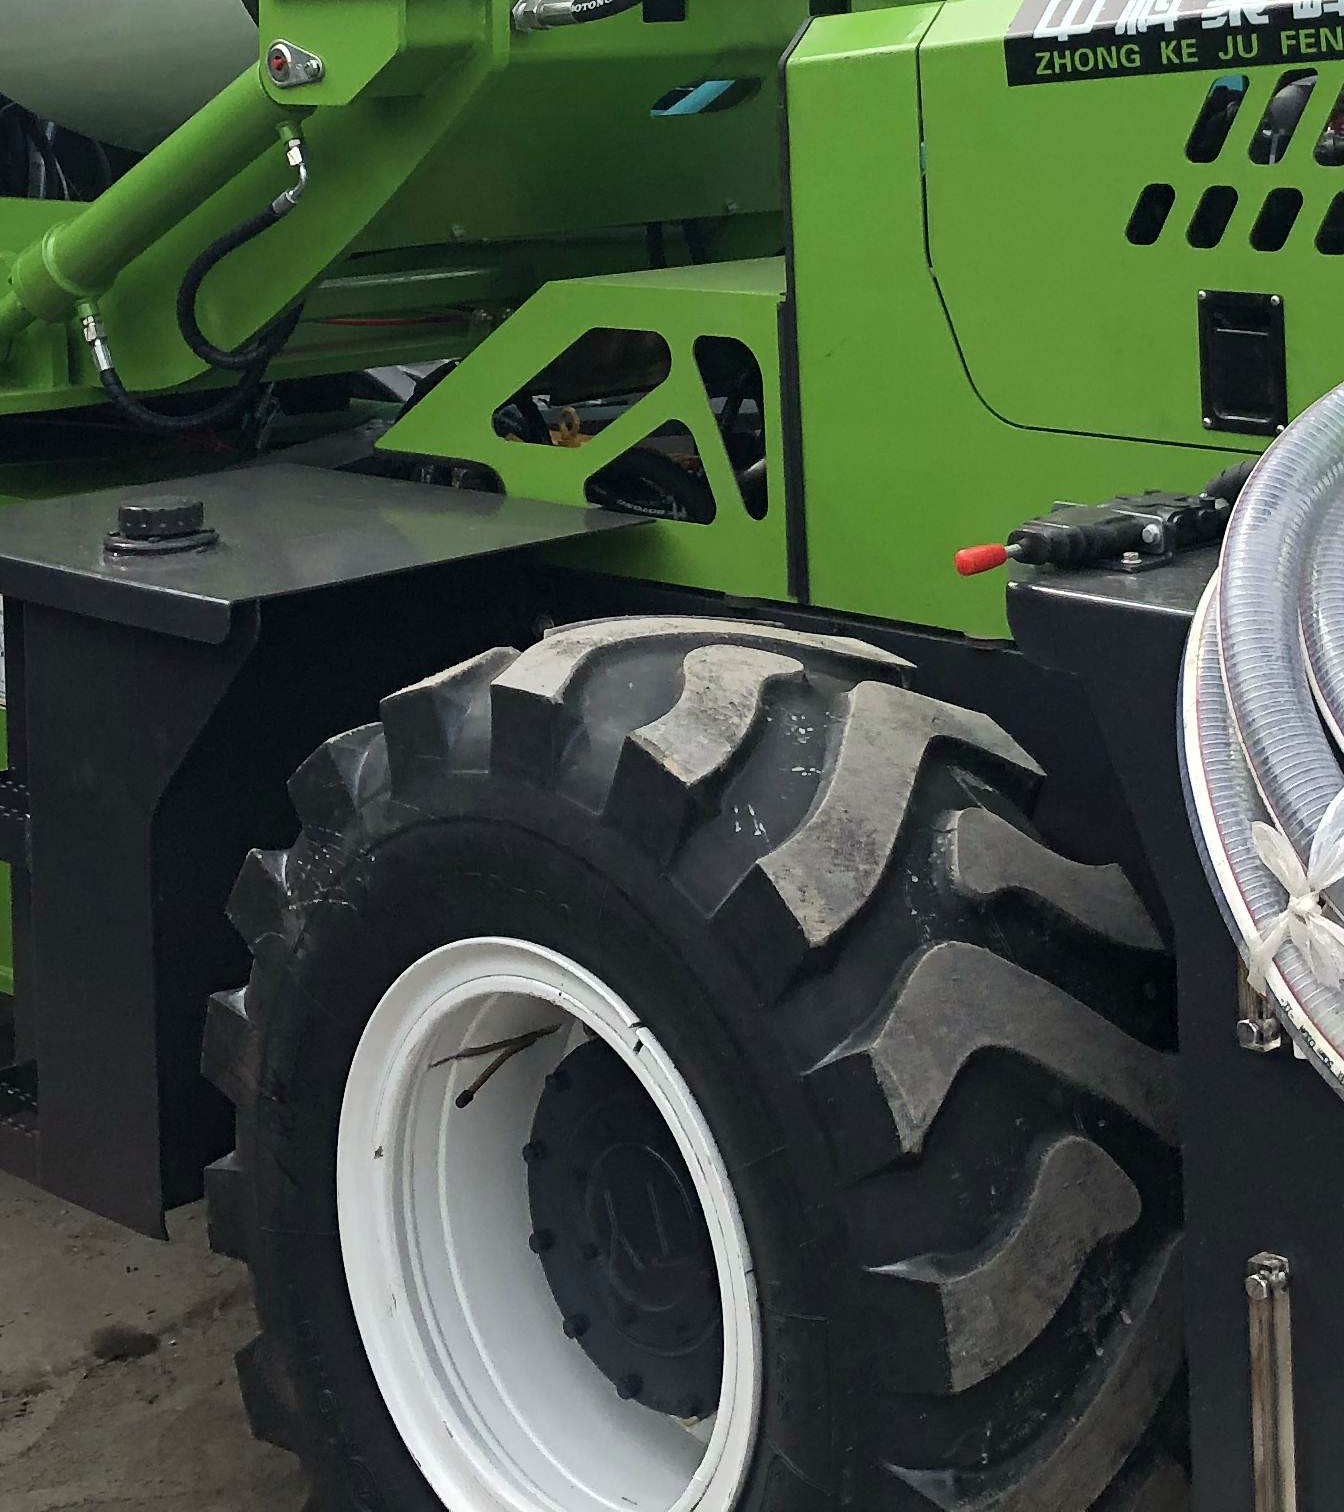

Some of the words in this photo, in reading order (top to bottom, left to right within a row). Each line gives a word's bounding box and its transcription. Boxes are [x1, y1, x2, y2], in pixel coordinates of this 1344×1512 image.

[1035, 44, 1141, 76] ZHONG
[1161, 38, 1199, 66] KE
[1219, 33, 1258, 61] JU
